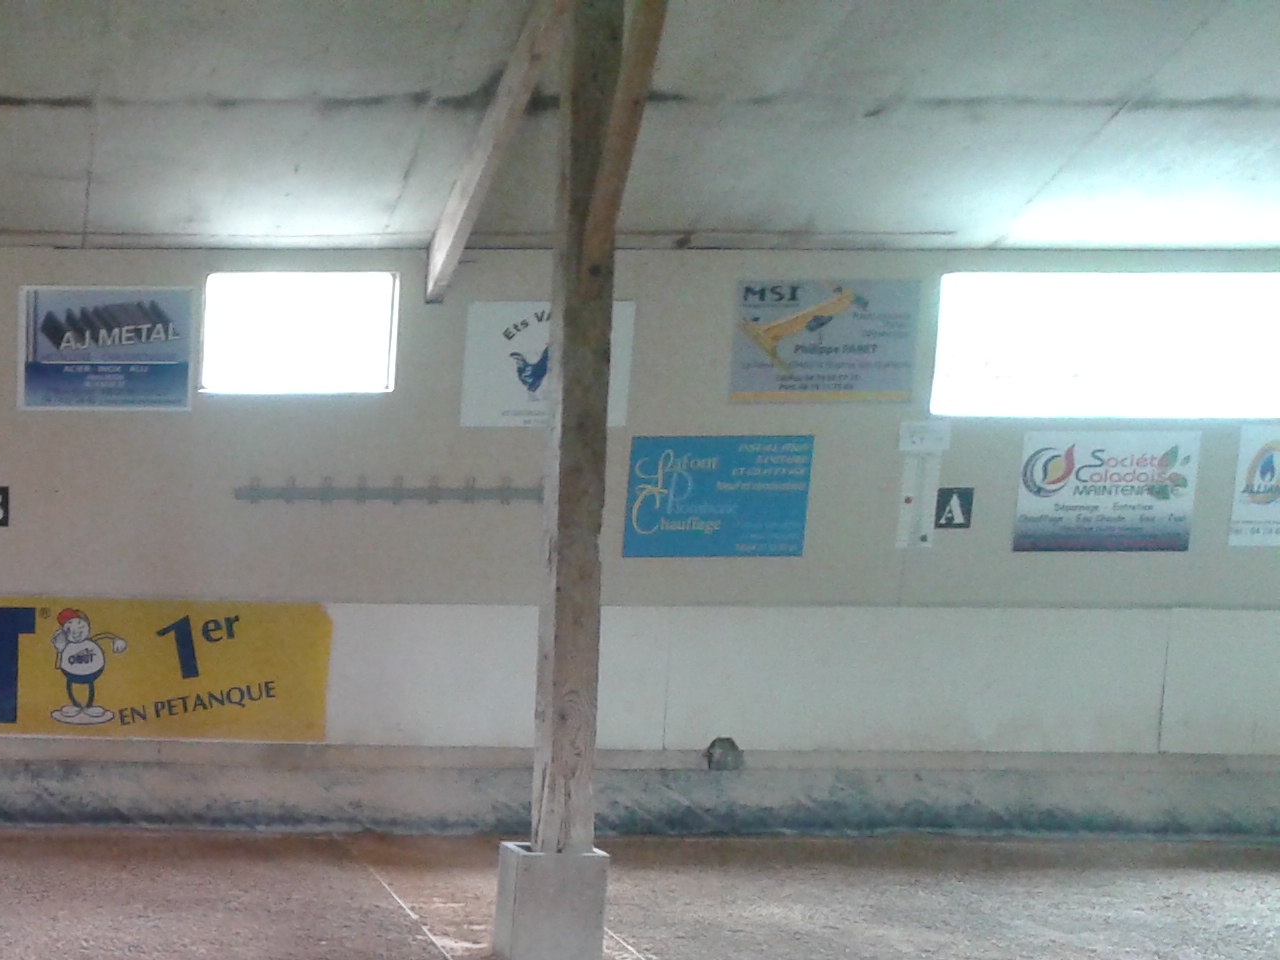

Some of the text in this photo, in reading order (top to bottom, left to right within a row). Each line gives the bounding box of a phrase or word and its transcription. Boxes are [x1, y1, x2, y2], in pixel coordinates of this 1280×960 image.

[743, 285, 801, 302] MSI
[58, 322, 182, 351] AJ METAL
[502, 318, 530, 341] Ets
[939, 493, 967, 525] A
[156, 614, 241, 680] 1er
[119, 680, 276, 726] EN PETANQUE
